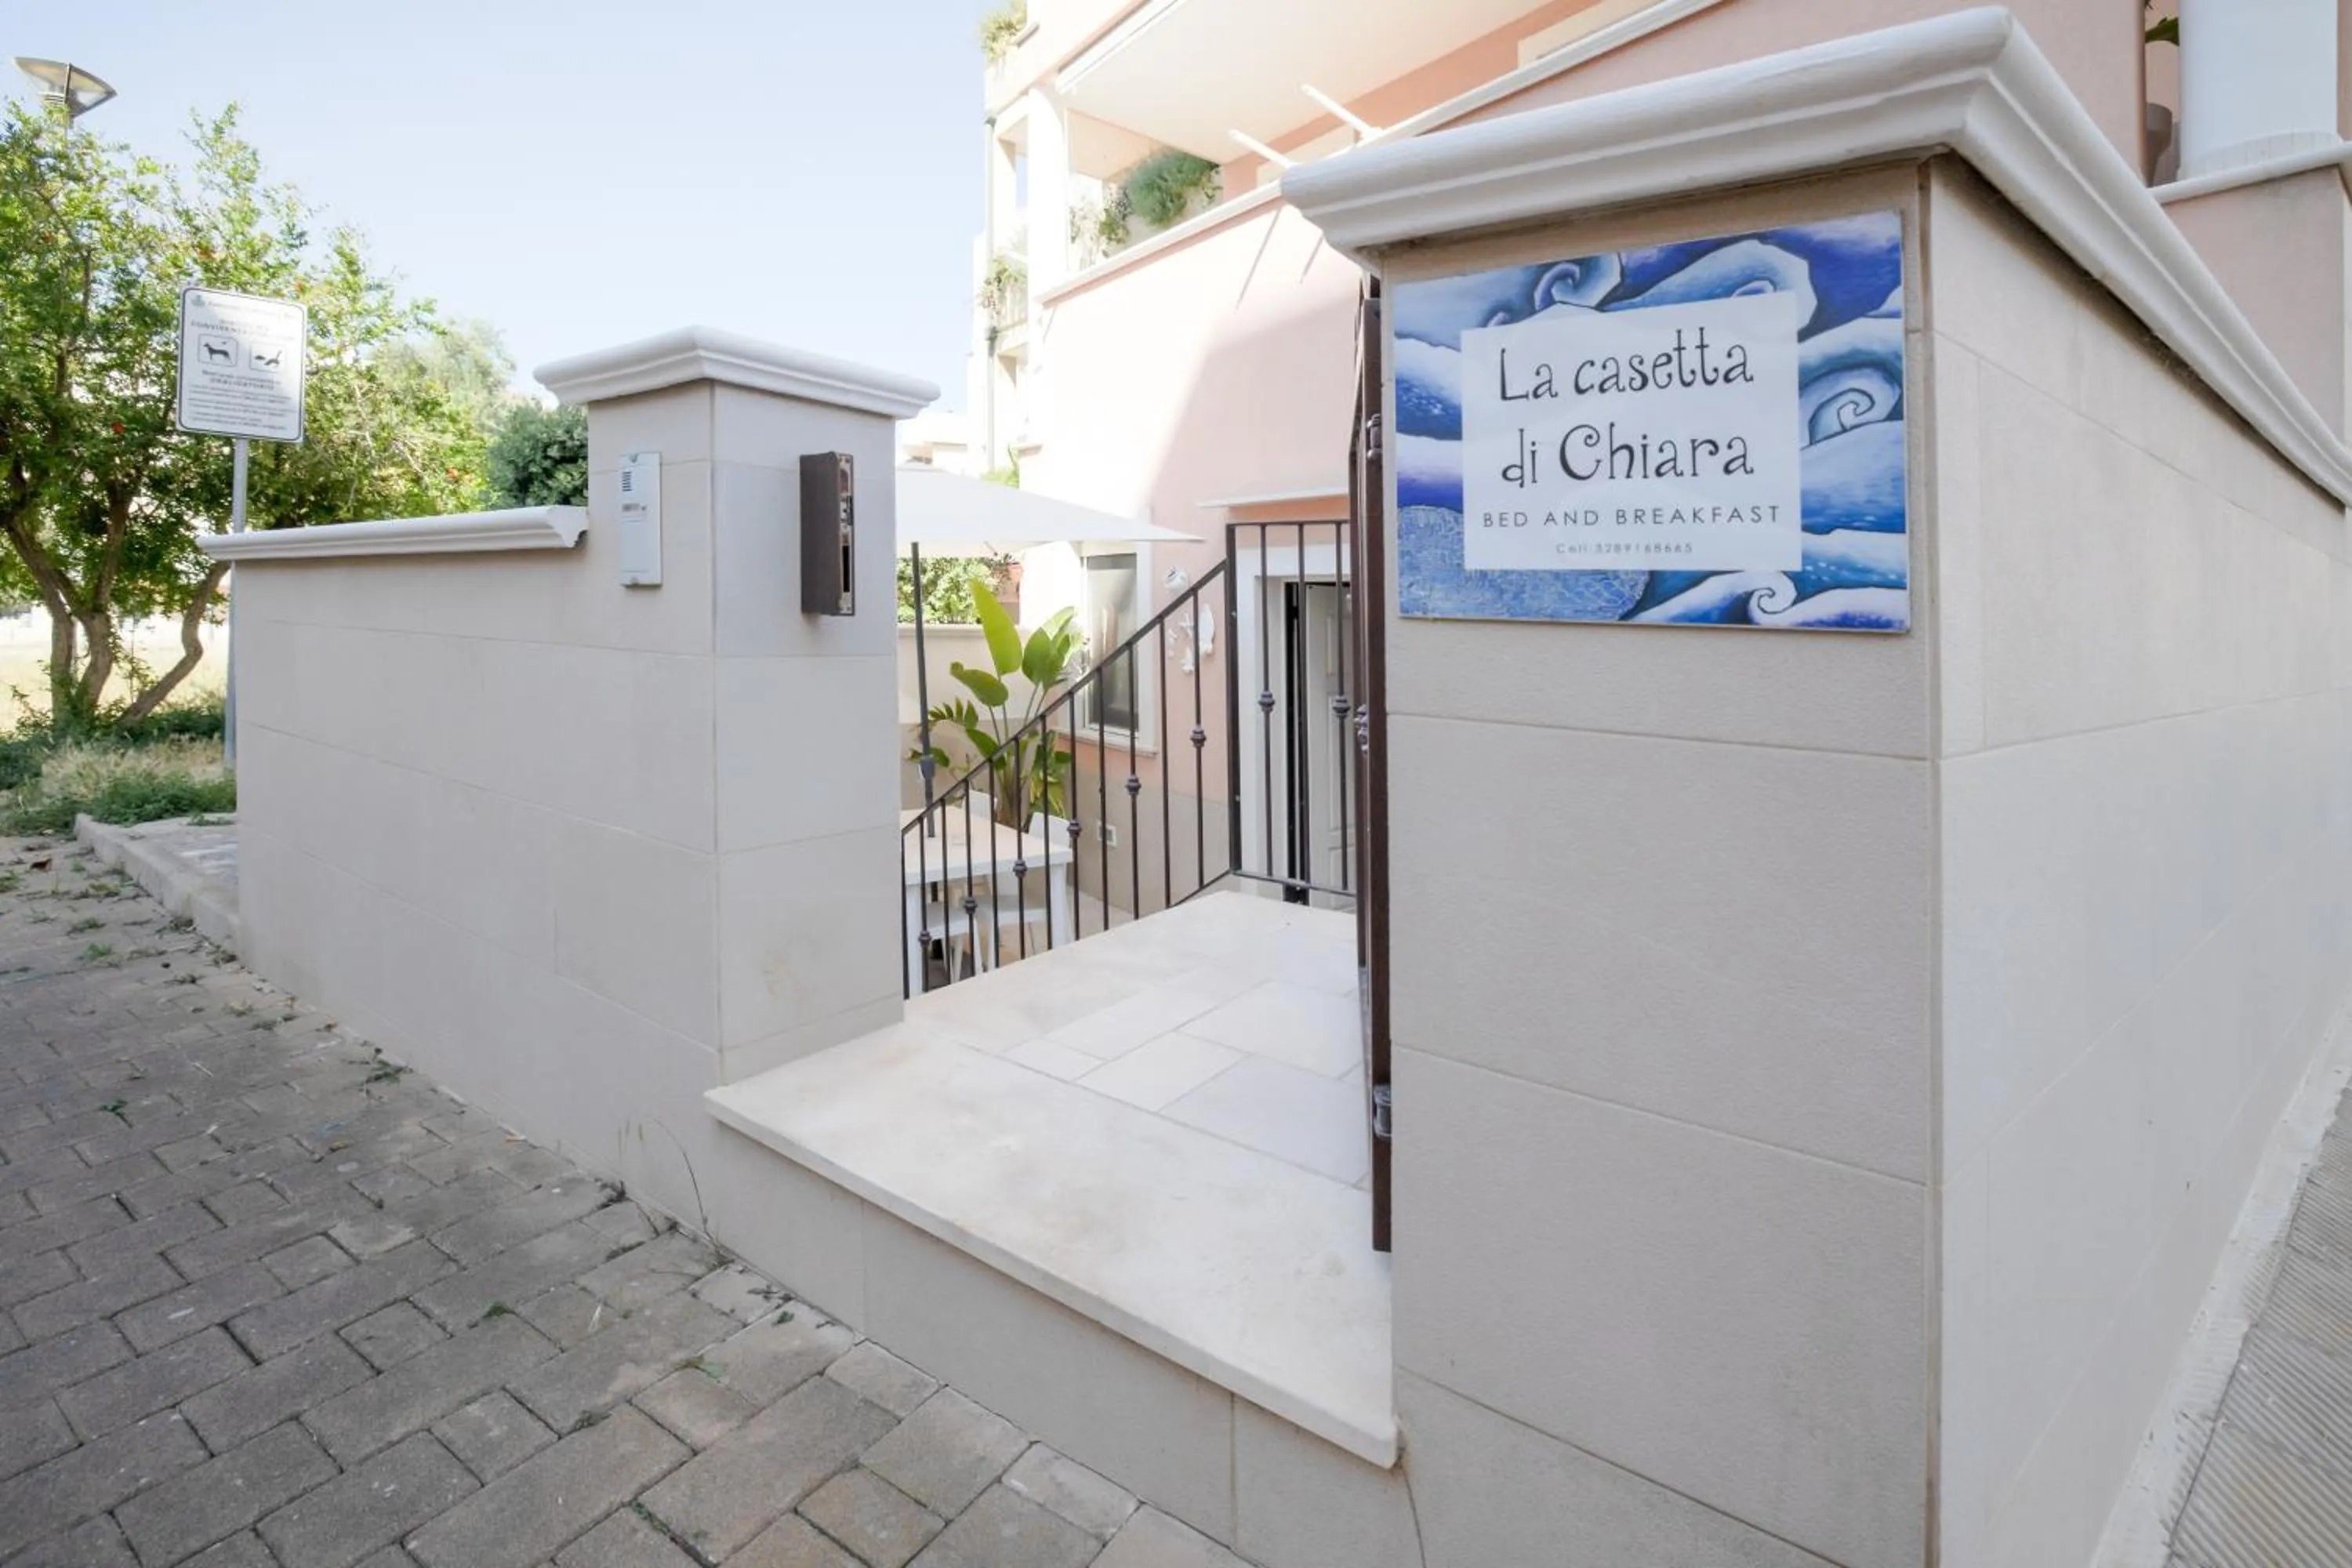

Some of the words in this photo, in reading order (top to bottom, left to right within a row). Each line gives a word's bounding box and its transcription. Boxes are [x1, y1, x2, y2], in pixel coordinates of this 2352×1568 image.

[1499, 347, 1559, 401] La
[1573, 326, 1755, 395] casetta
[1501, 427, 1538, 489] di
[1559, 421, 1755, 481] Chiara
[1483, 511, 1528, 528] BED
[1543, 510, 1599, 527] AND
[1615, 505, 1780, 526] BREAKFAST
